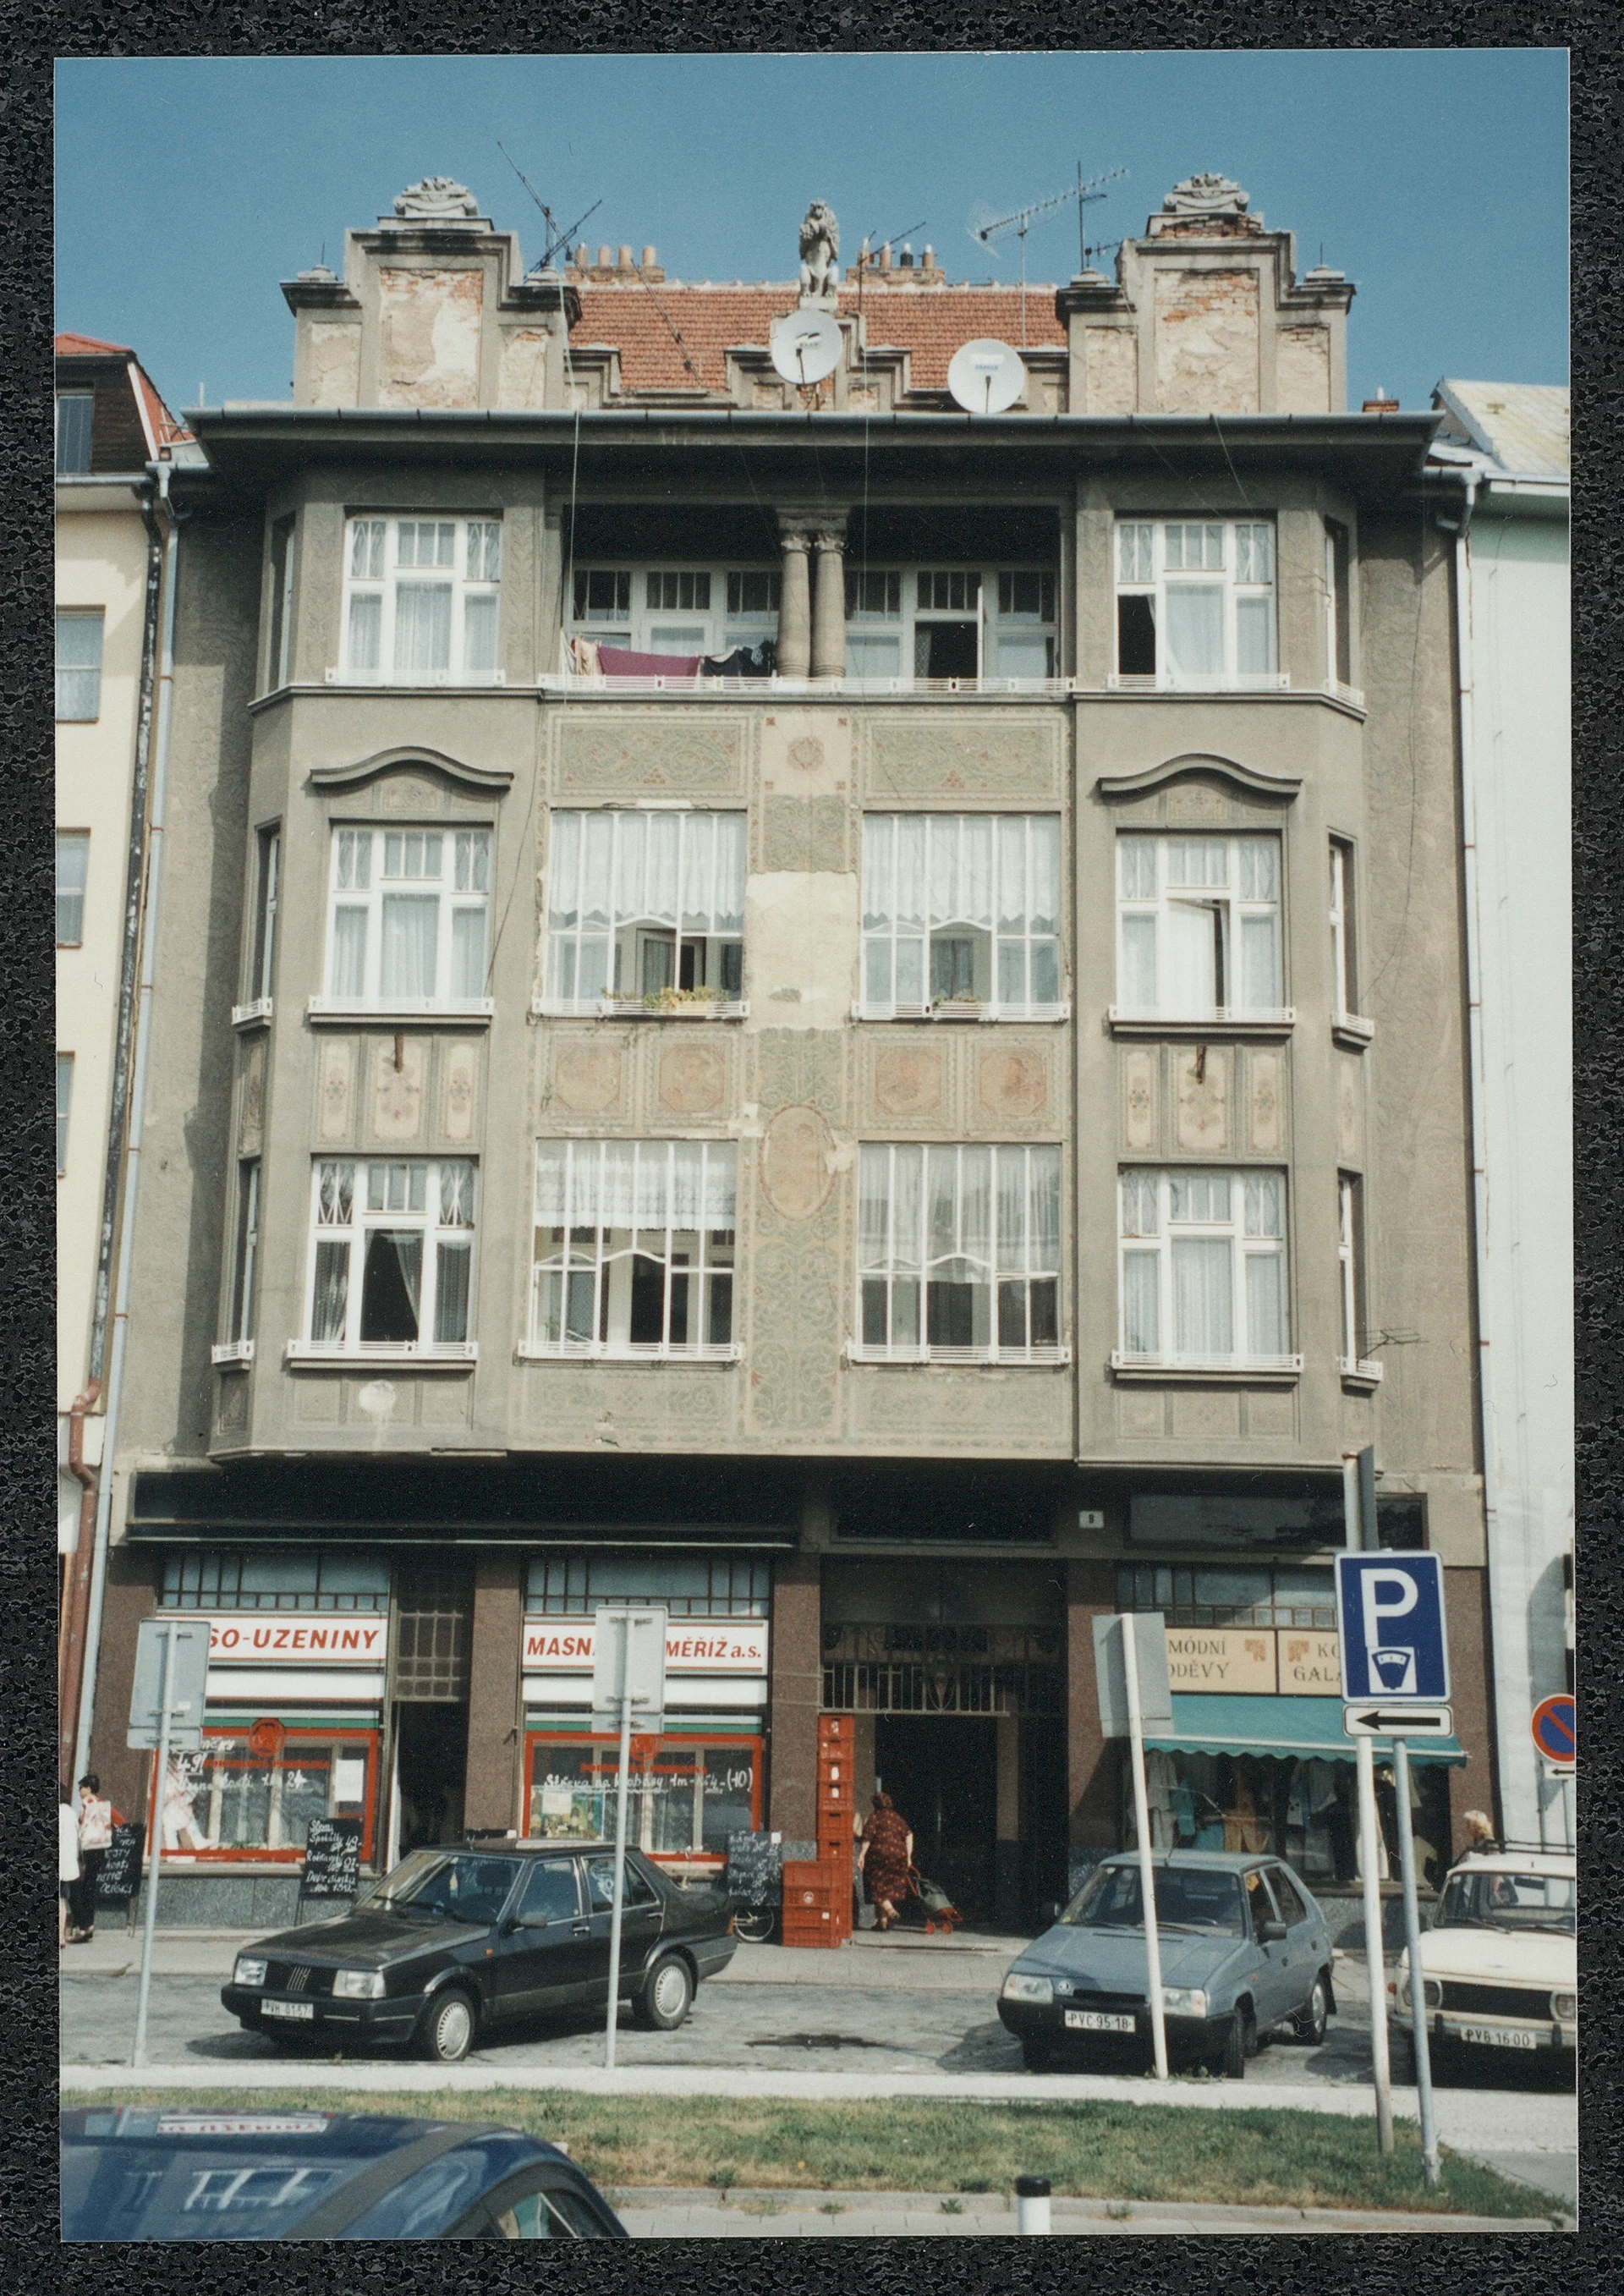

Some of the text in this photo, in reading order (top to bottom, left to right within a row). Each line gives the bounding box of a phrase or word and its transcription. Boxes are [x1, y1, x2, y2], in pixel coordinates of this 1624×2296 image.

[1360, 1568, 1419, 1648] P
[210, 1628, 380, 1649] SO-UZENINY
[527, 1636, 762, 1658] MASN MĚŘÍŽ a.s.
[1170, 1659, 1231, 1678] DĚVY
[1293, 1666, 1340, 1682] GAL
